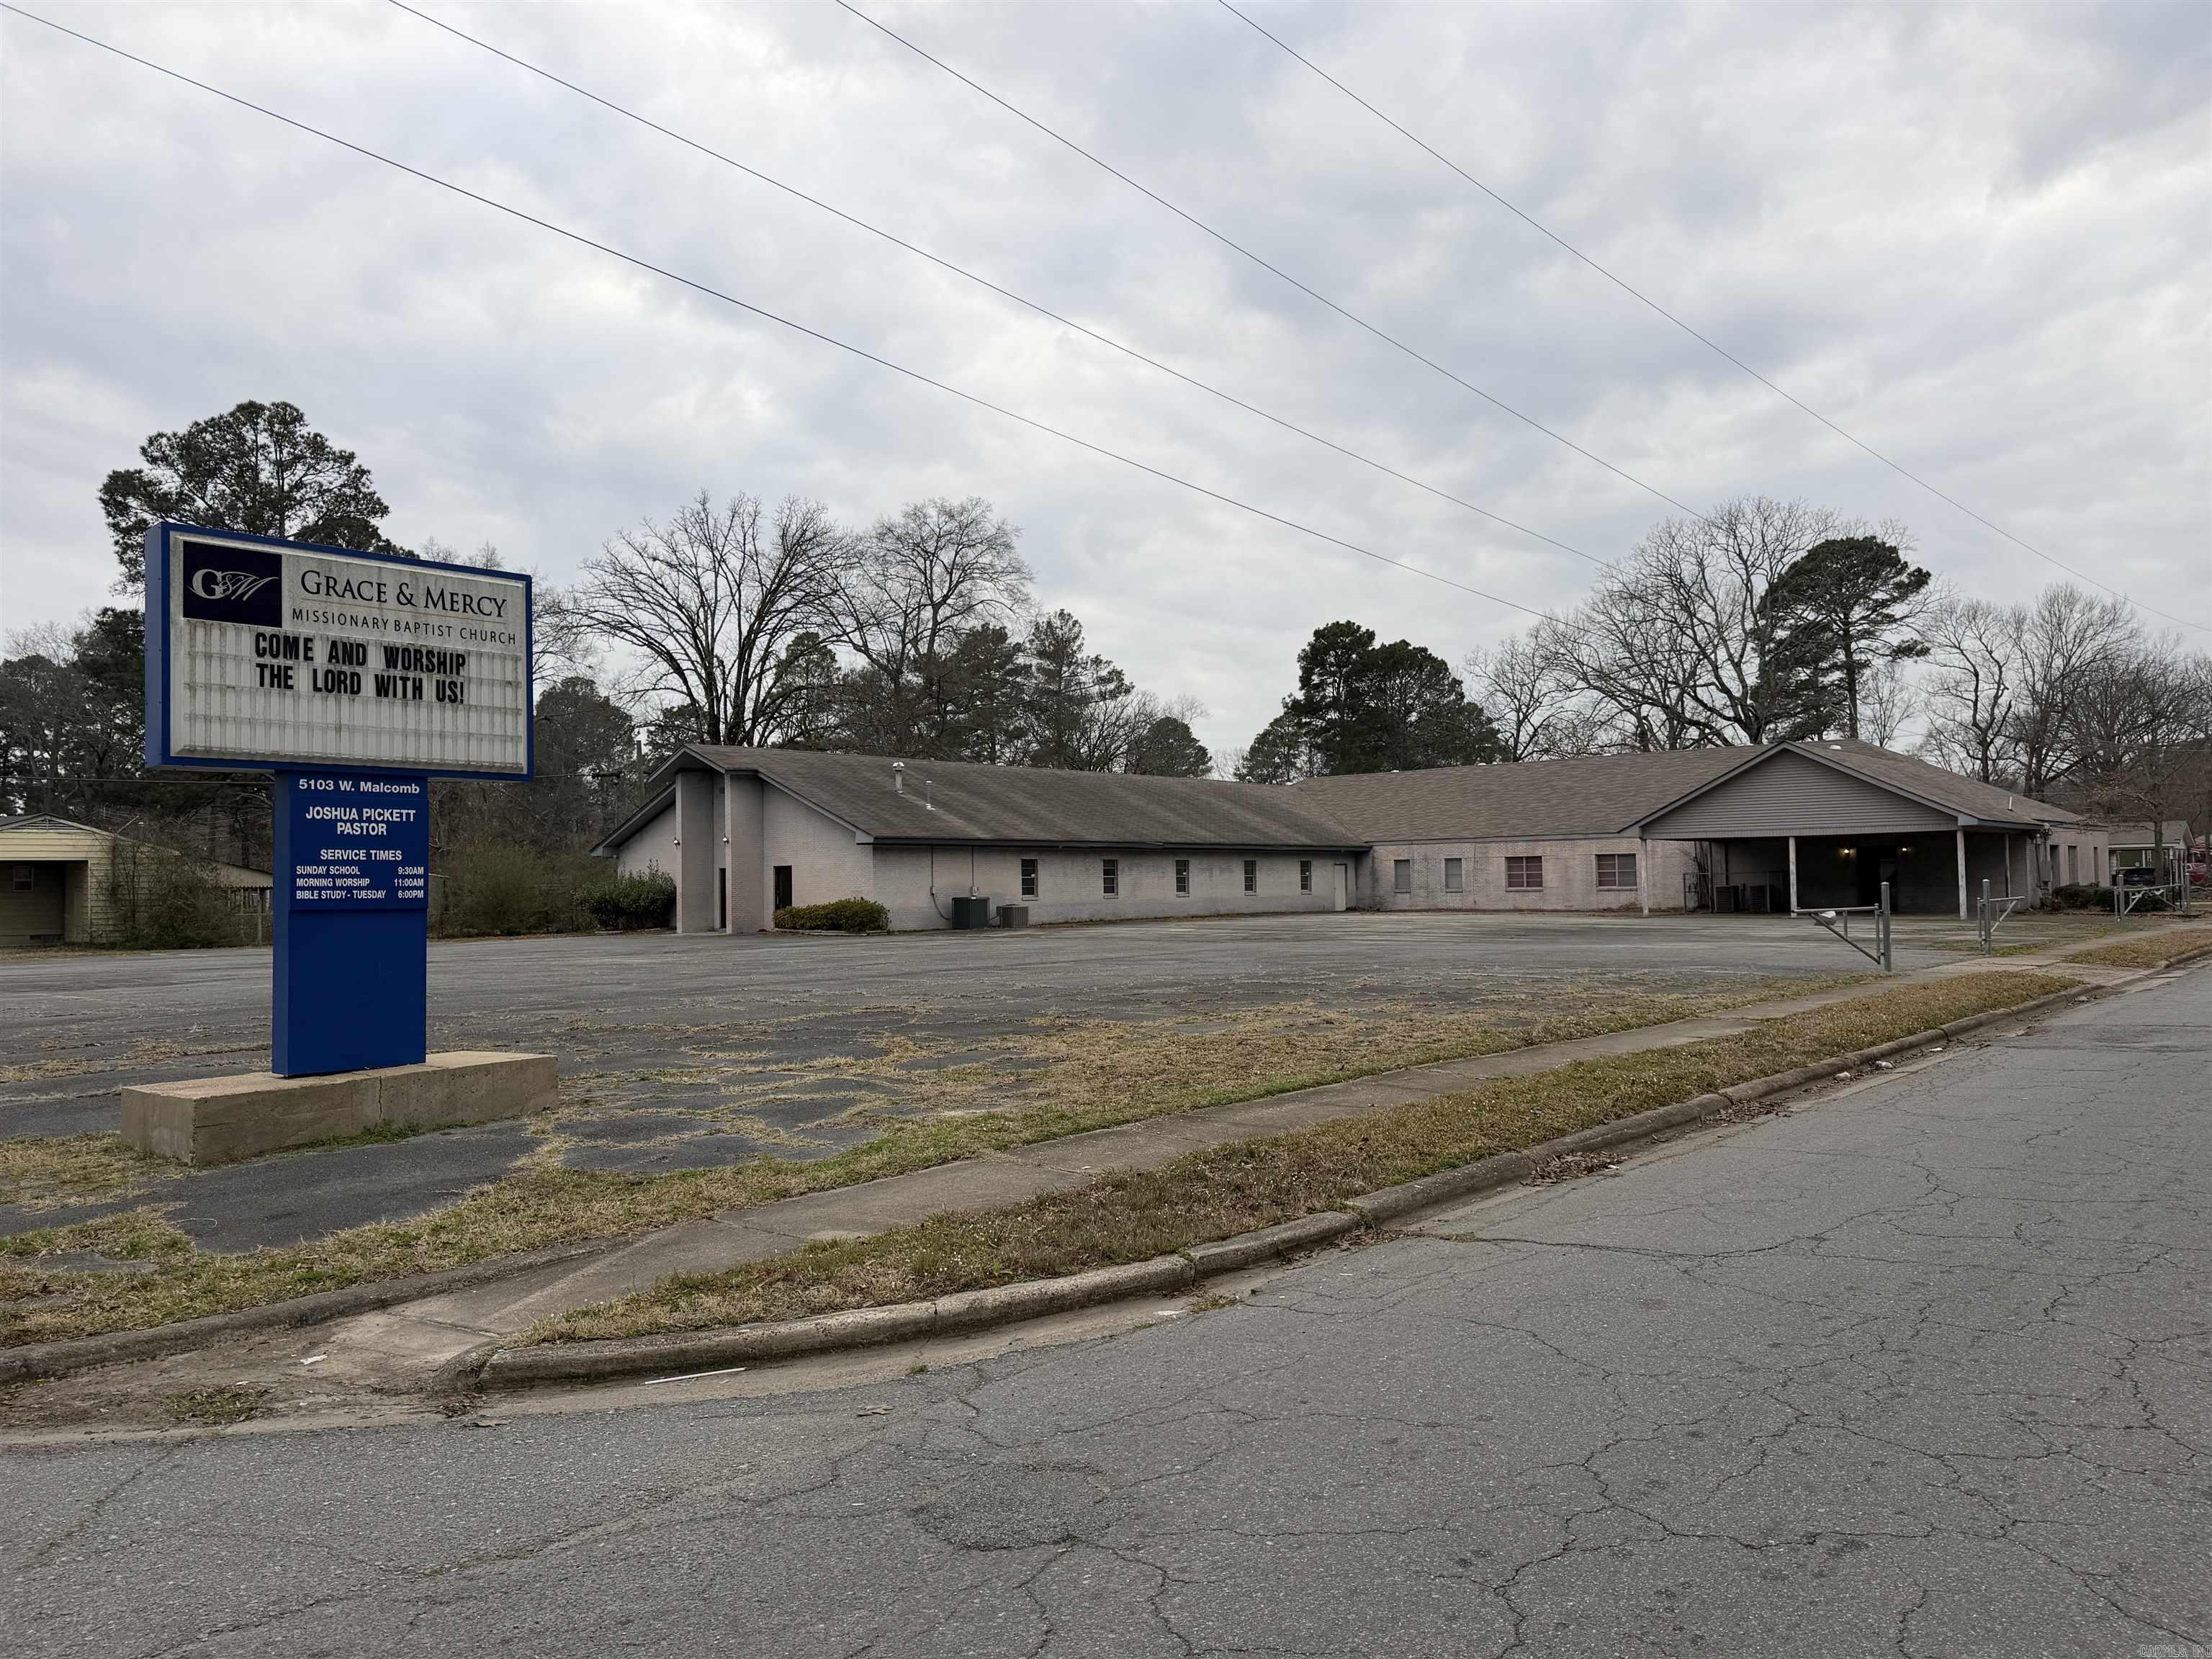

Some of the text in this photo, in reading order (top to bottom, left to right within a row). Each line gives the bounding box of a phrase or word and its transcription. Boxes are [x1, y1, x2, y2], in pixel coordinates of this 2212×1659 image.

[301, 570, 507, 618] GRACE & MERCY
[292, 608, 516, 644] MISSIONARY BAPTIST CHURCH
[255, 632, 466, 675] COME AND WORSHIP
[256, 662, 464, 703] THE LORD WITH US!
[299, 779, 420, 793] 5103 W. Malcomb
[305, 806, 415, 822] JOSHUA PICKETT
[337, 822, 387, 835] PASTOR
[320, 849, 403, 860] SERVICE TIMES
[296, 866, 327, 874] SUNDAY
[397, 866, 424, 875] 9:30AM
[296, 891, 319, 899] BIBLE
[352, 890, 386, 899] TUESDAY
[397, 890, 424, 899] 6:00PM
